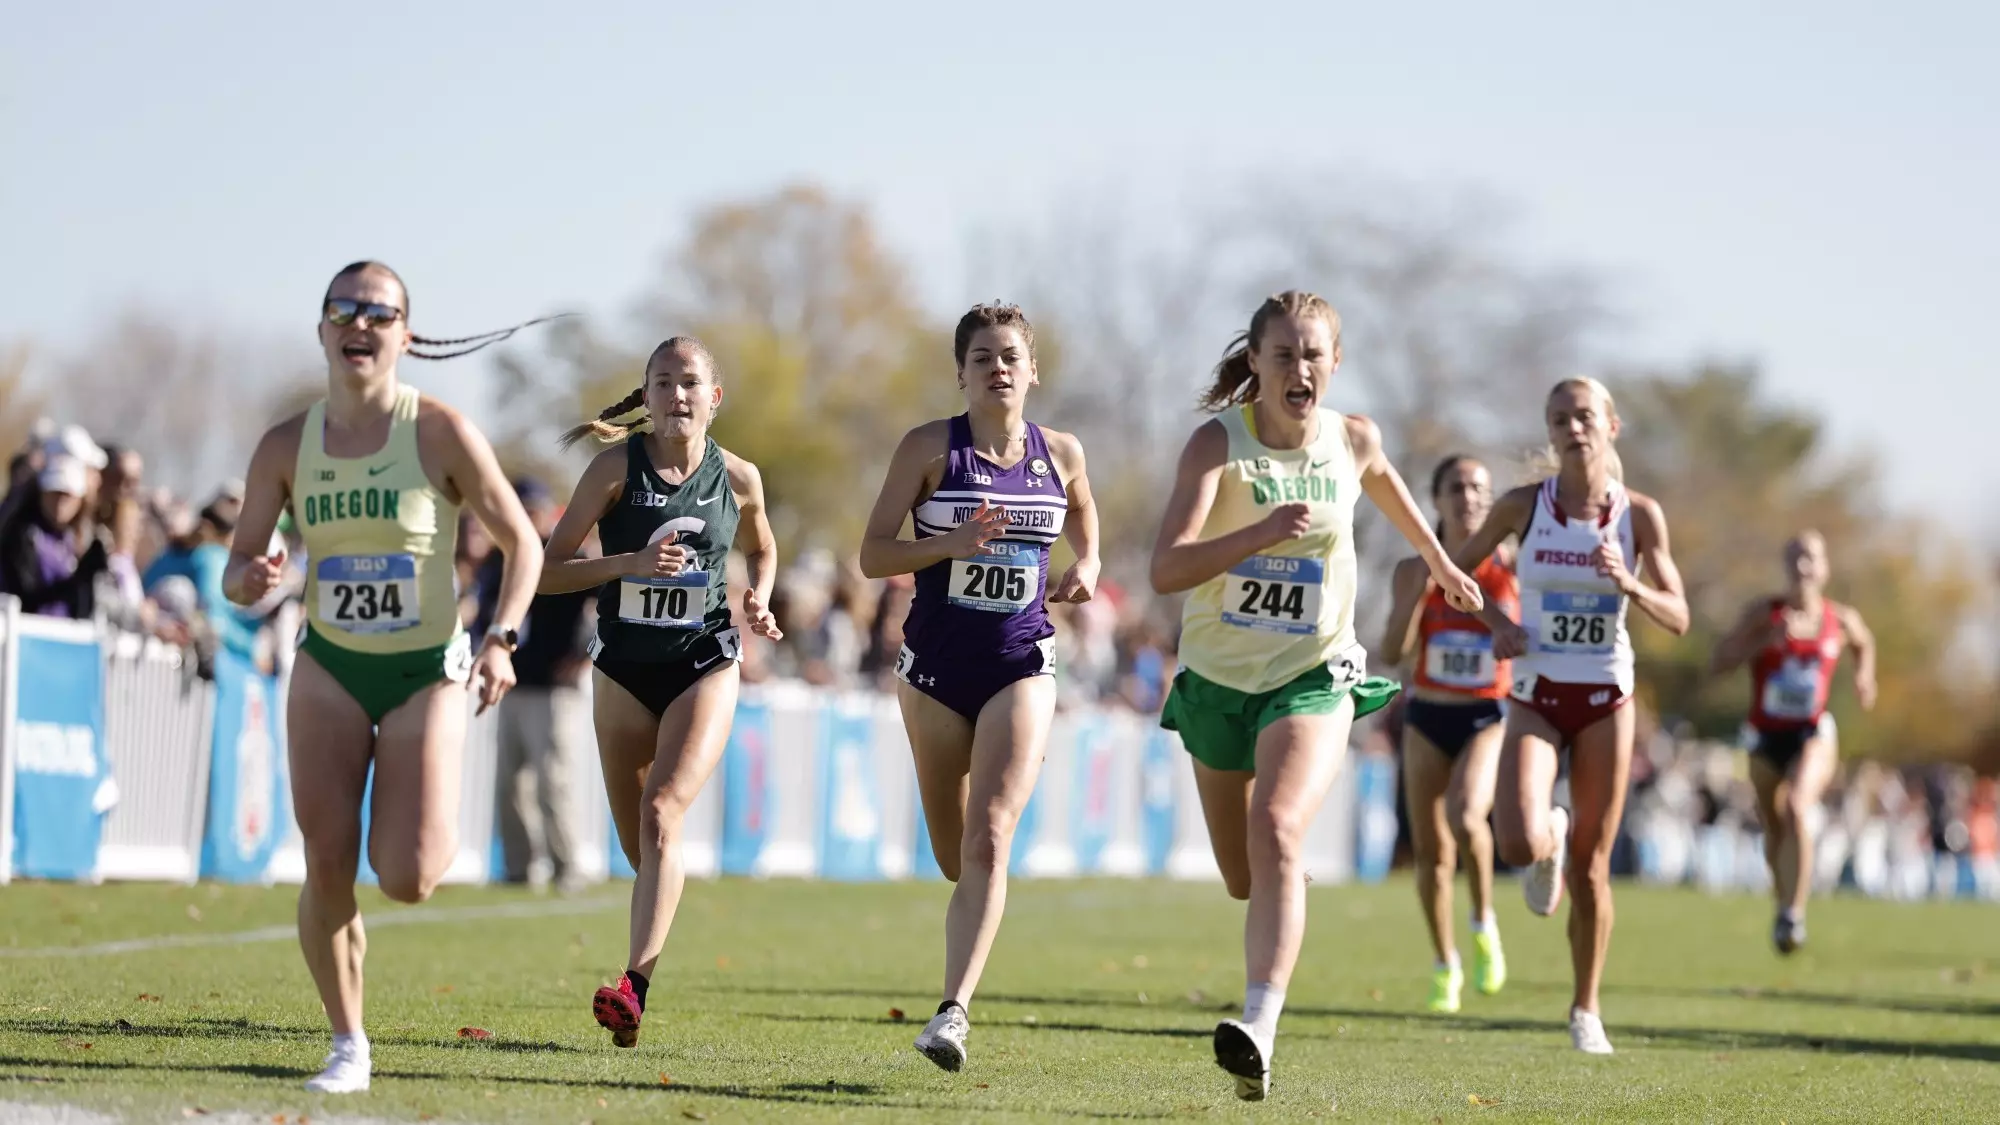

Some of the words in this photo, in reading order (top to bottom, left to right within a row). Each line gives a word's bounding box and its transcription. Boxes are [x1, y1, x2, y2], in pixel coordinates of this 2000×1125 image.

[305, 488, 399, 526] OREGON
[1252, 475, 1337, 505] OREGON
[333, 583, 403, 620] 234
[963, 564, 1026, 602] 205
[1239, 580, 1304, 620] 244
[639, 587, 687, 619] 170
[1552, 616, 1605, 644] 326
